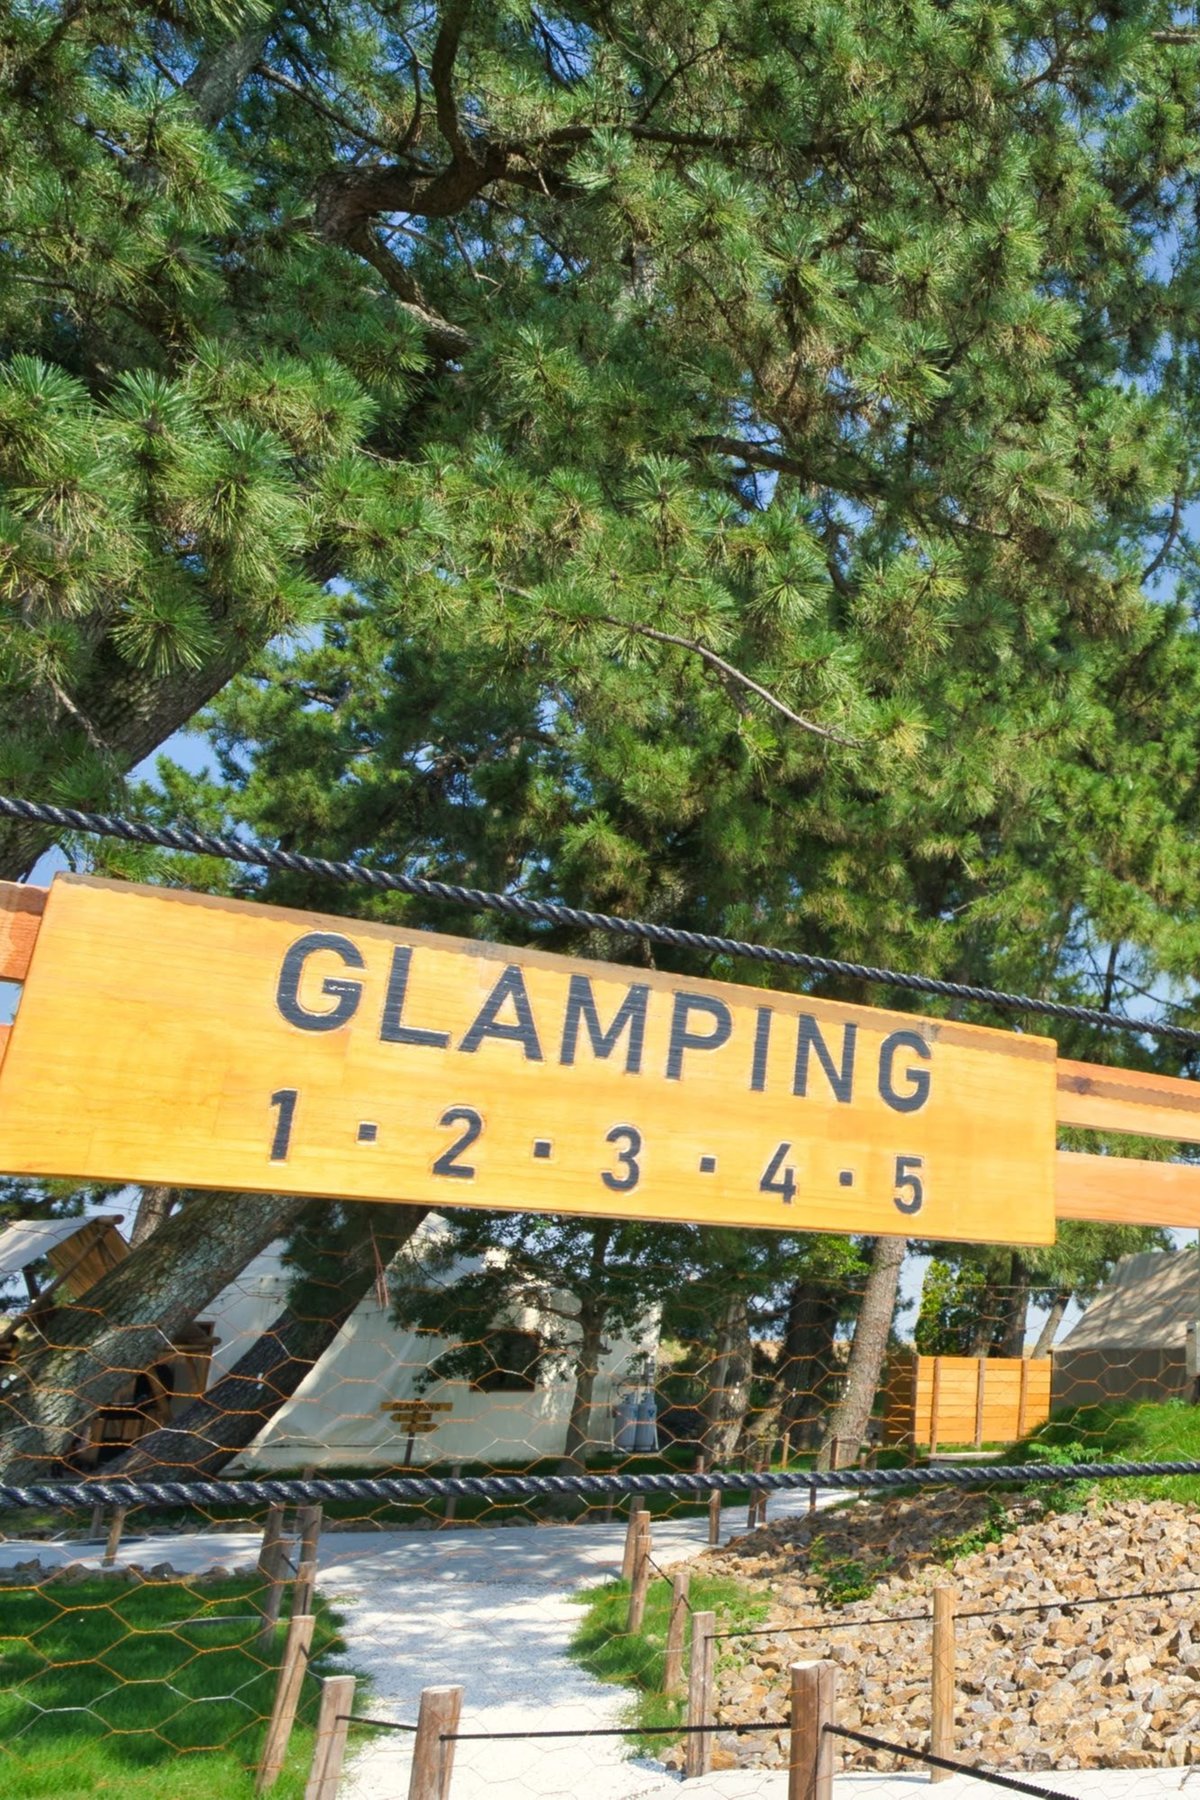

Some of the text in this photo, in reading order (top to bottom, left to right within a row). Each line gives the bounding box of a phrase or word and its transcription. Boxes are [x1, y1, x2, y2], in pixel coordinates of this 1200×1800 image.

[276, 930, 932, 1113] GLAMPING
[270, 1089, 923, 1215] 1 2 3 4 5
